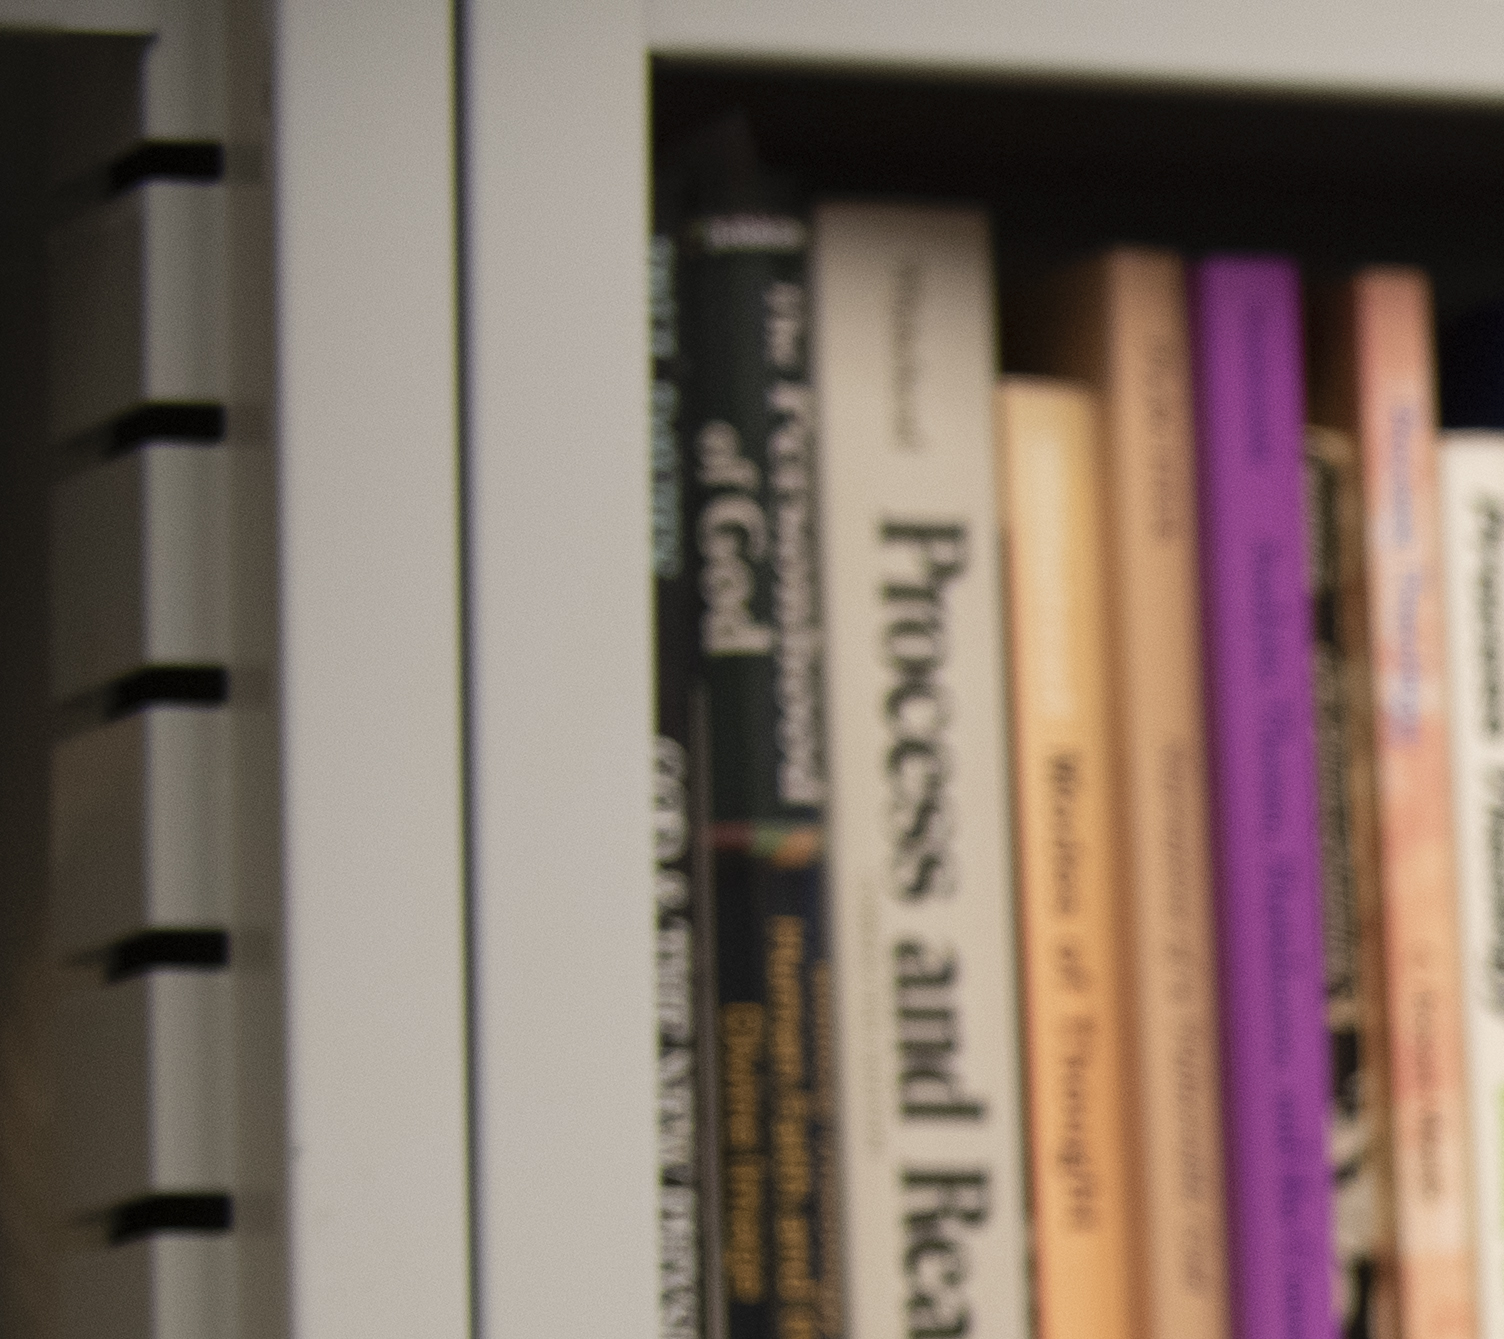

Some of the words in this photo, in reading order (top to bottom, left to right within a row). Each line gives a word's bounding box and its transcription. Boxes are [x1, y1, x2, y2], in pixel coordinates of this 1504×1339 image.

[697, 497, 777, 656] God
[876, 515, 972, 906] Process
[889, 935, 992, 1127] and
